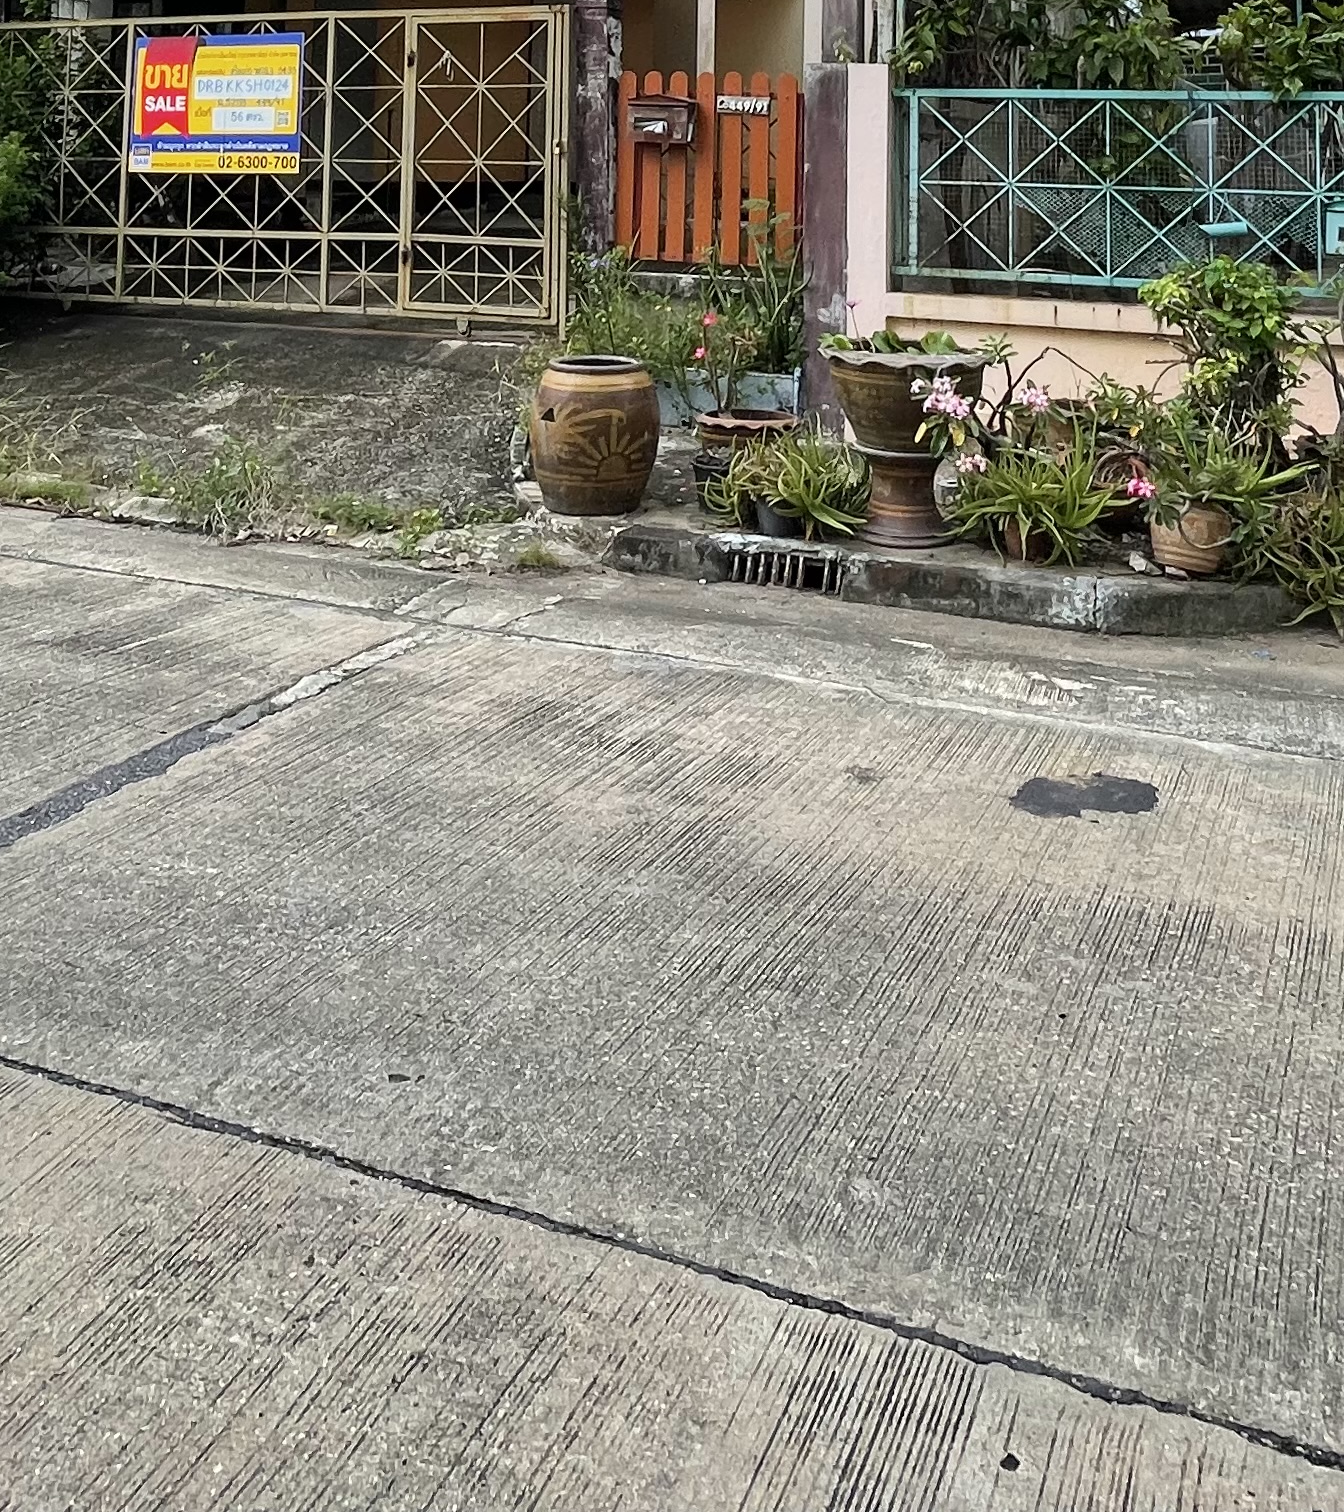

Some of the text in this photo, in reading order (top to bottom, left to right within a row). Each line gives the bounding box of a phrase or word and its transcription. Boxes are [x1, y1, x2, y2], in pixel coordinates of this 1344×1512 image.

[145, 63, 189, 89] ขาย
[145, 95, 187, 112] SALE
[218, 155, 297, 169] 02-6300-700
